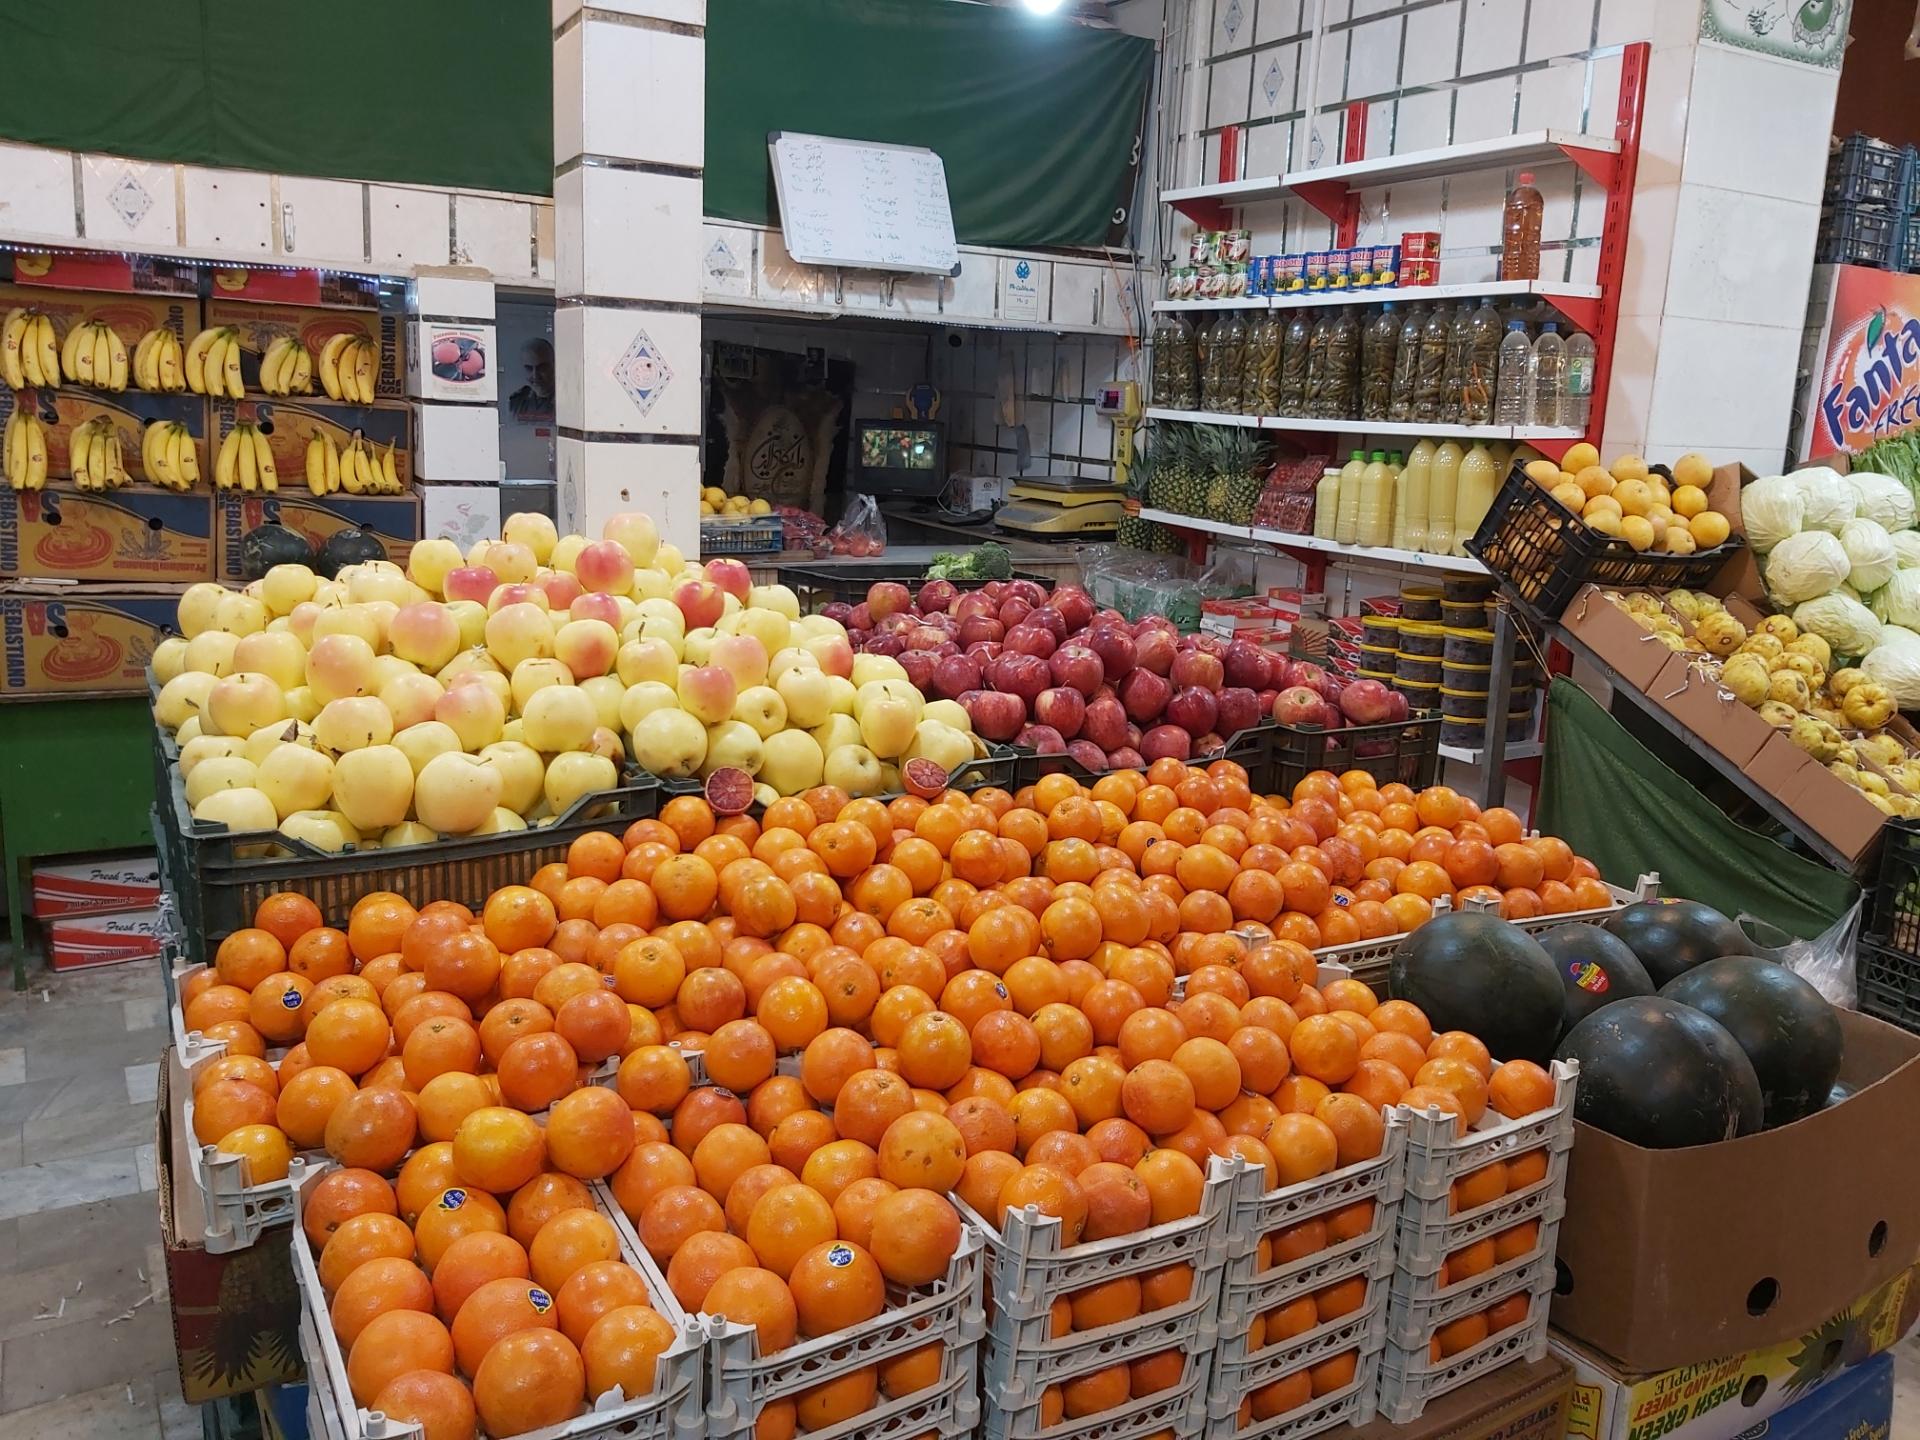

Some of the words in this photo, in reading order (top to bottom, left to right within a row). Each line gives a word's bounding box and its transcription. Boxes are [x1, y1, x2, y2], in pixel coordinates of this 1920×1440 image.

[381, 315, 397, 395] SEBASTIANO
[1823, 318, 1920, 448] Fanta
[226, 494, 243, 576] SEBASTIANO
[4, 598, 26, 688] SEBASTIANO
[90, 868, 122, 881] Fresh
[105, 920, 135, 932] Fresh
[531, 1296, 550, 1305] SUPER
[1683, 1373, 1712, 1400] AND
[1711, 1353, 1747, 1386] JUICY
[1632, 1387, 1683, 1422] SWEET
[1691, 1373, 1745, 1420] FRESH
[1505, 1401, 1560, 1440] SWEET
[1628, 1403, 1689, 1440] GREEN
